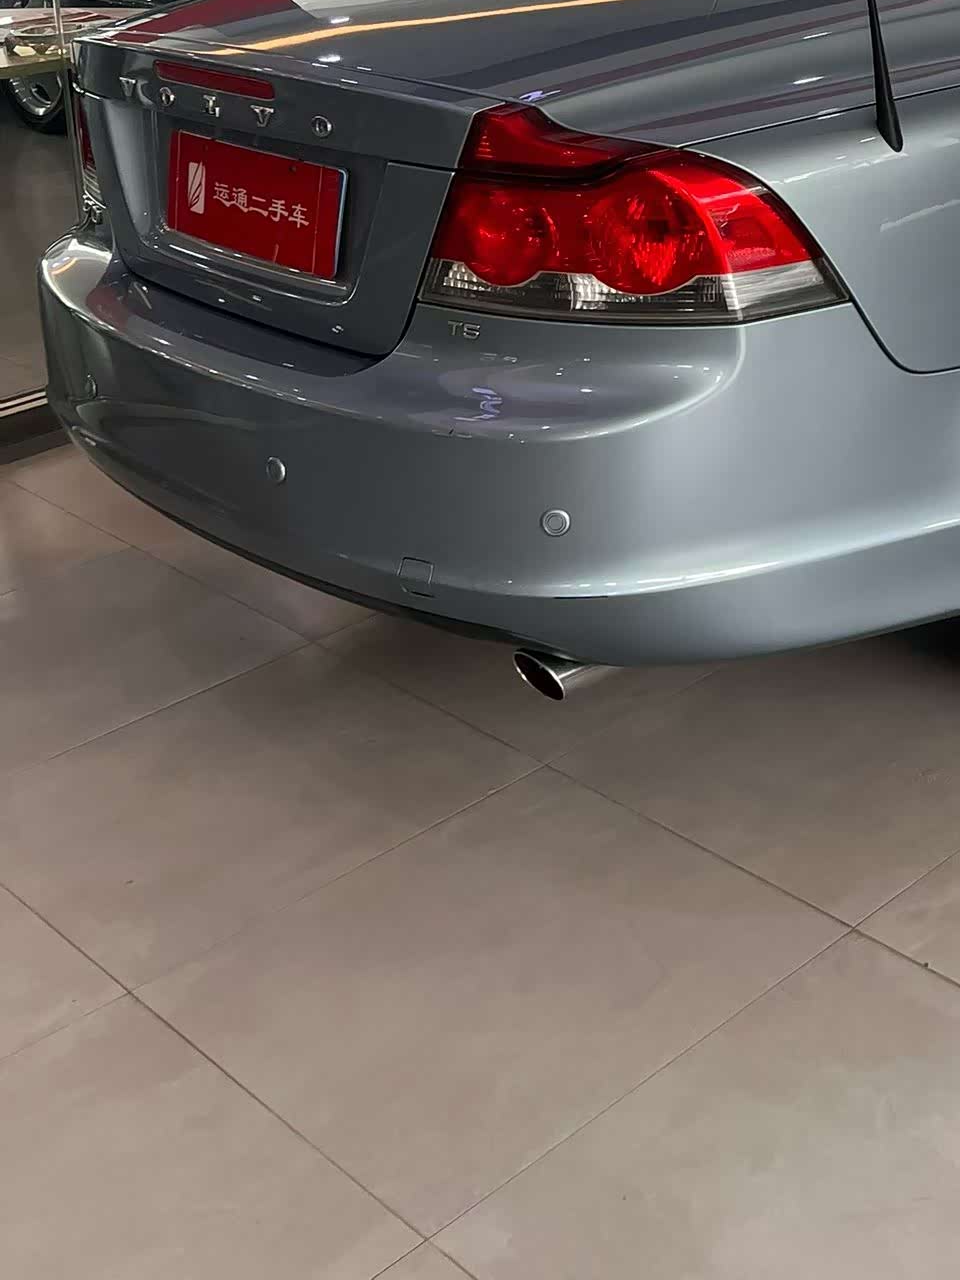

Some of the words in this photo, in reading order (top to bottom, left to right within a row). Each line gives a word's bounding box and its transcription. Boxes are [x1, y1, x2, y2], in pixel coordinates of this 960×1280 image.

[119, 76, 334, 138] VOLVO
[211, 180, 311, 229] 运通二手车
[447, 320, 481, 340] T5
